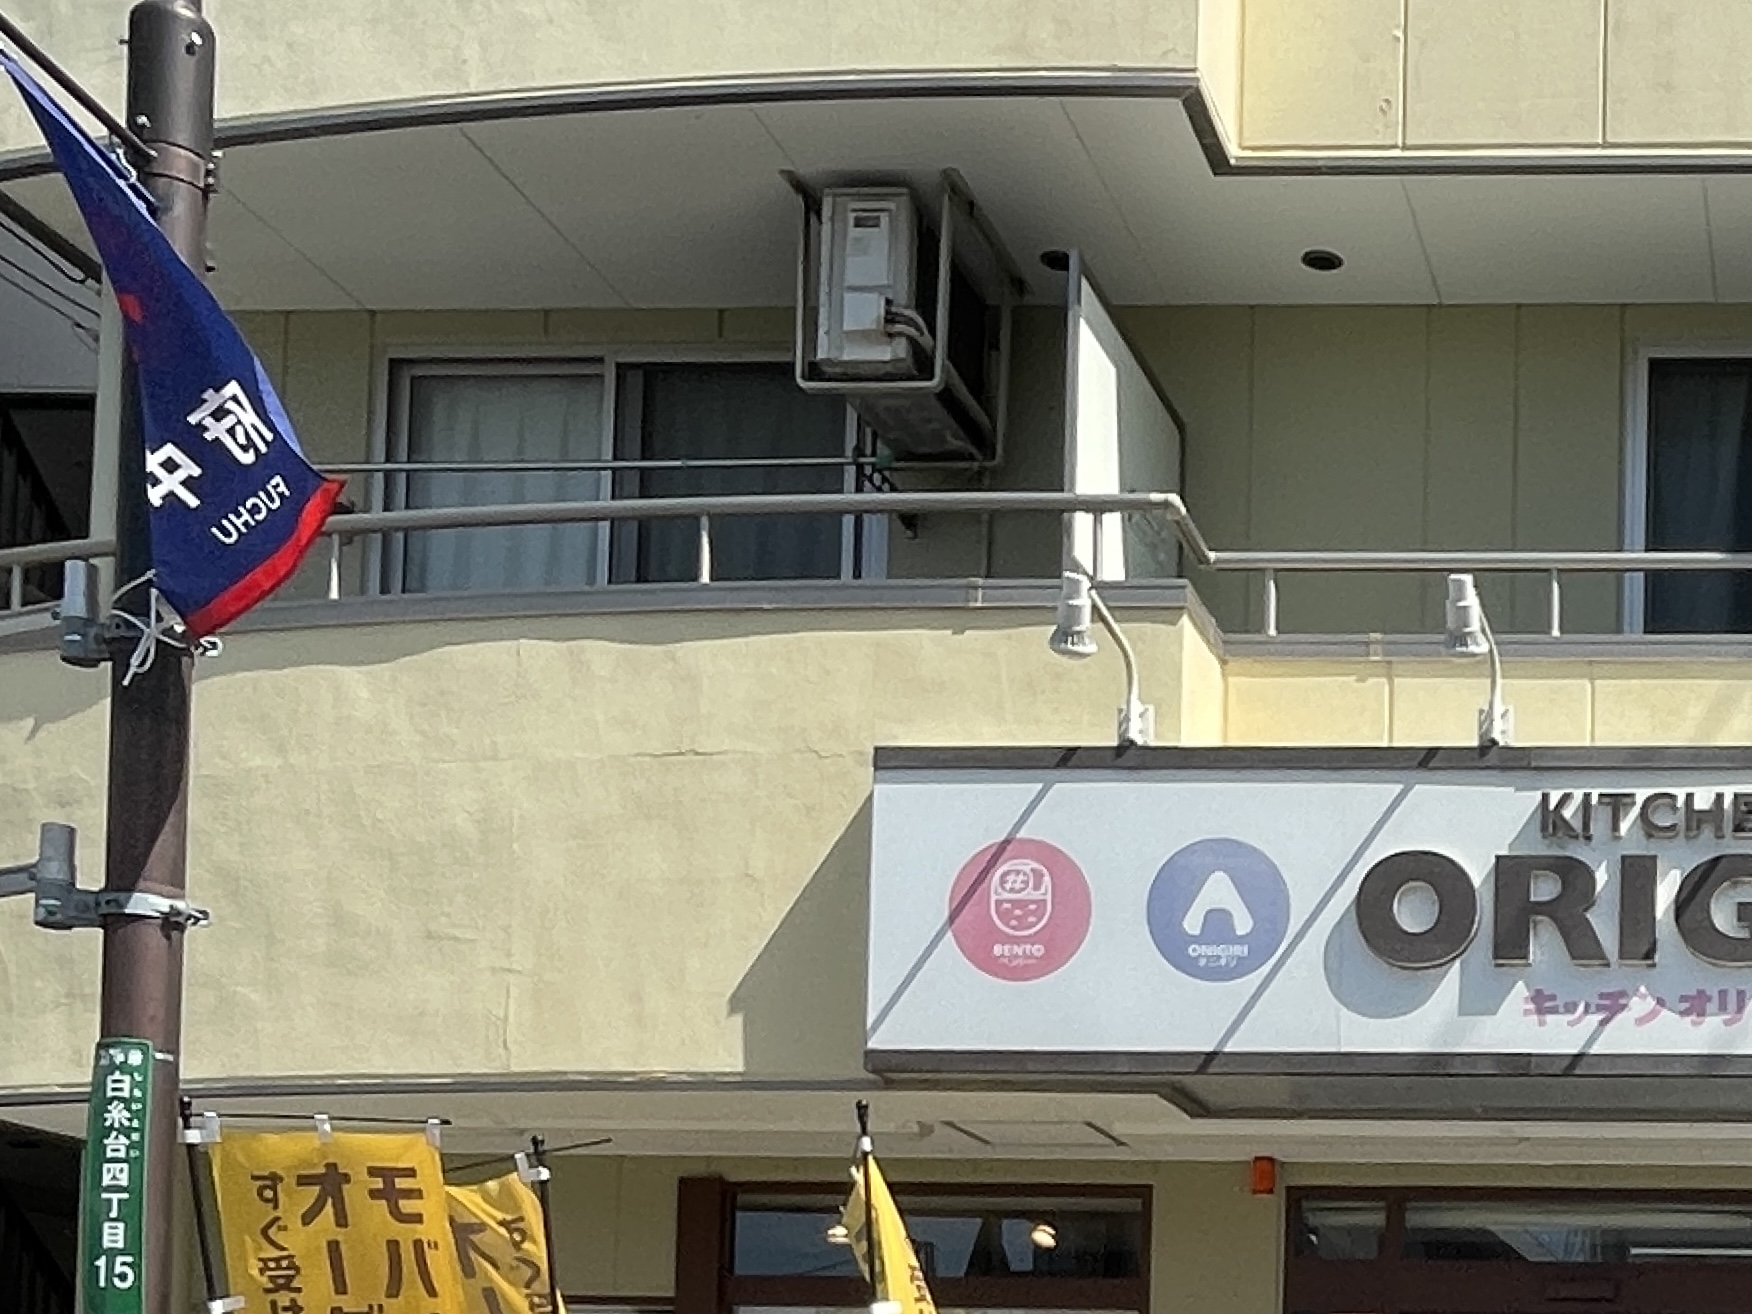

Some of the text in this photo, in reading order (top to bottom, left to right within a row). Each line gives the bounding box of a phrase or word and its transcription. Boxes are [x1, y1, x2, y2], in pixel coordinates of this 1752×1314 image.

[993, 944, 1045, 956] BENTO
[1188, 945, 1249, 956] ONIGIRI
[1524, 988, 1661, 1027] キッチン
[100, 1070, 131, 1250] 白糸台四丁目
[93, 1255, 135, 1290] 15
